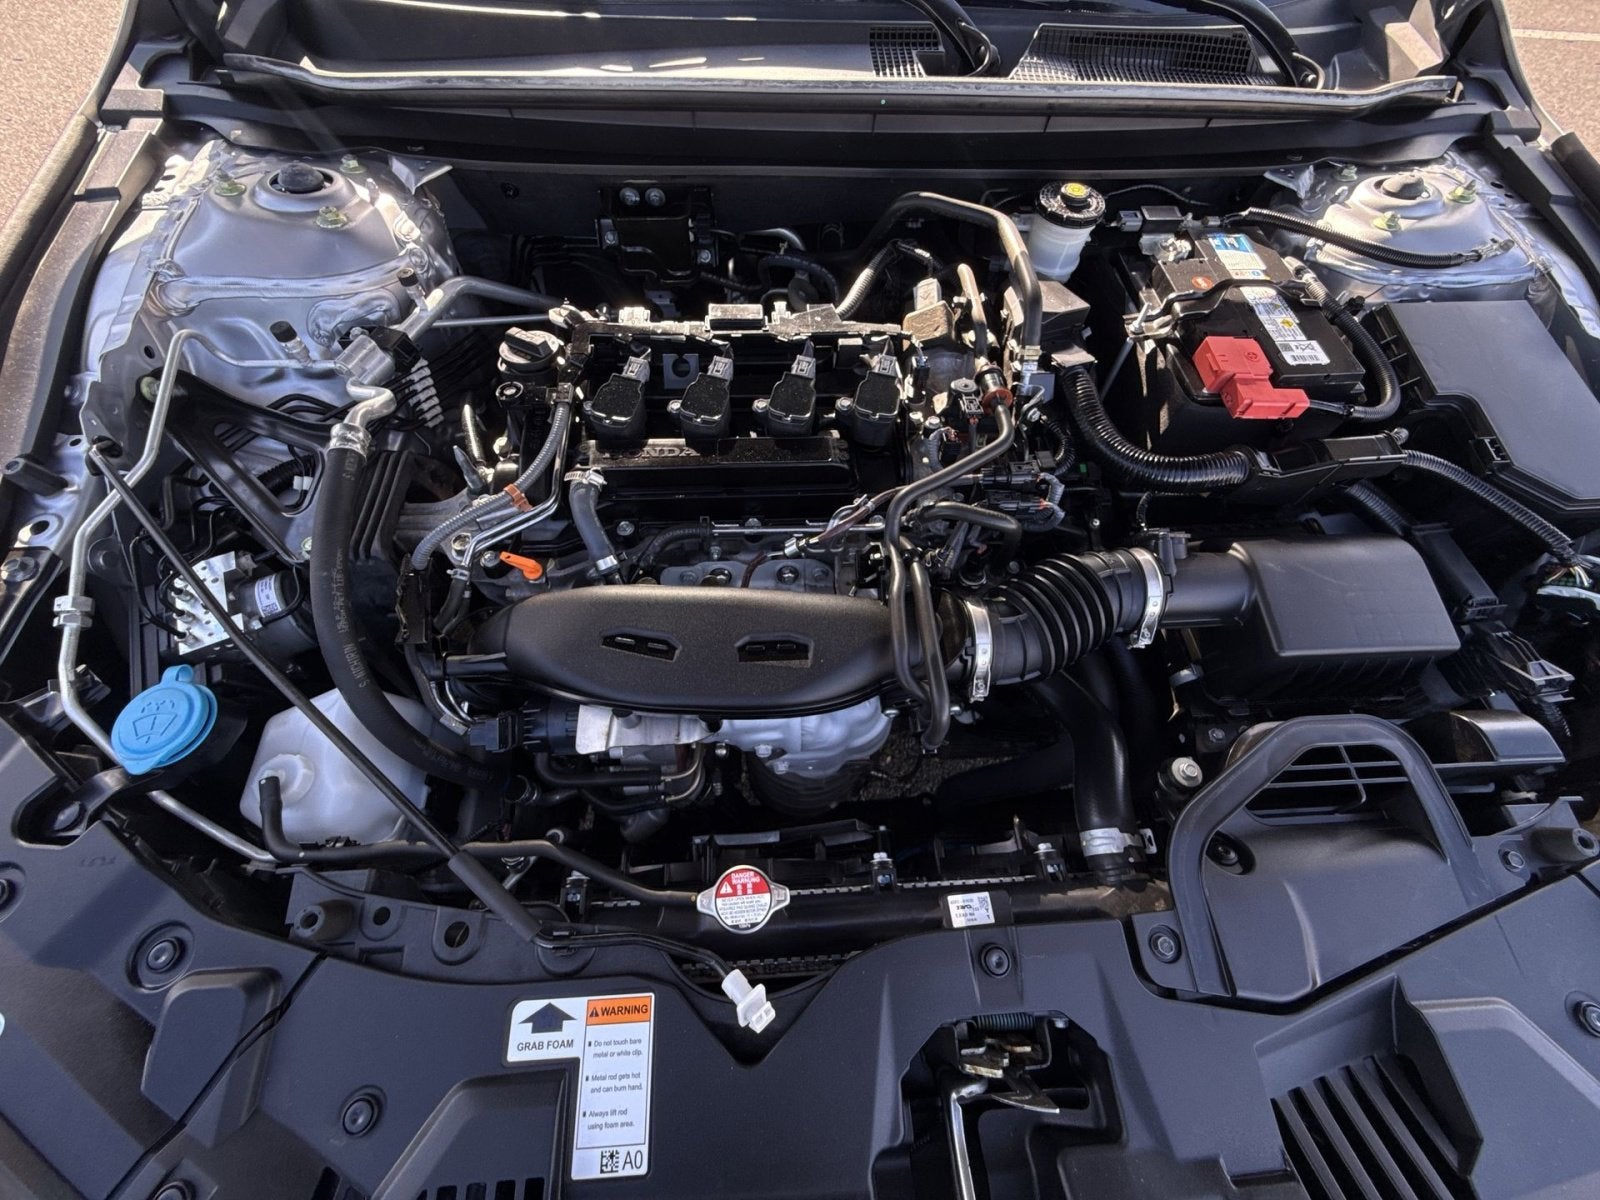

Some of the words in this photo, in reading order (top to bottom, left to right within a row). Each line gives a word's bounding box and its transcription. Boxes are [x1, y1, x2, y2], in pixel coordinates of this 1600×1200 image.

[600, 1004, 648, 1016] WARNING
[516, 1040, 544, 1052] GRAB
[546, 1039, 574, 1050] FOAM
[613, 1038, 628, 1046] touch
[632, 1049, 643, 1057] clip.
[618, 1073, 630, 1082] gets
[613, 1084, 627, 1092] burn
[627, 1083, 643, 1091] hand.
[588, 1110, 608, 1118] Always
[587, 1122, 603, 1130] using
[604, 1121, 619, 1129] foam
